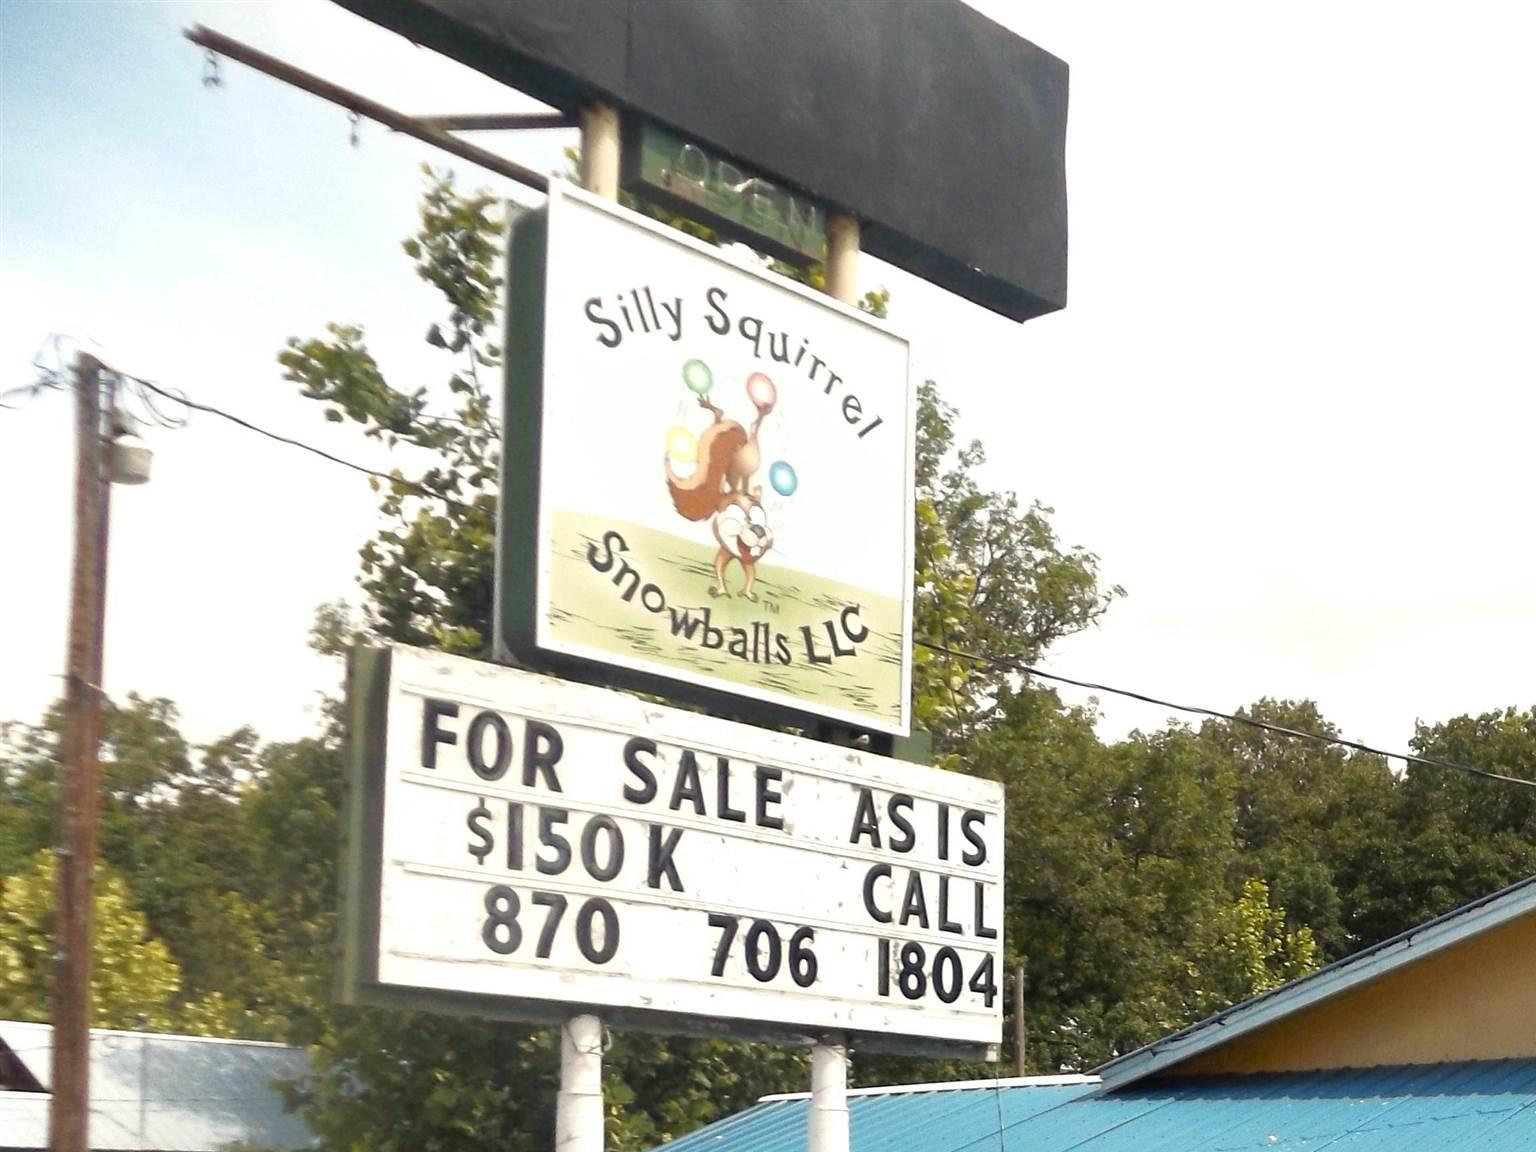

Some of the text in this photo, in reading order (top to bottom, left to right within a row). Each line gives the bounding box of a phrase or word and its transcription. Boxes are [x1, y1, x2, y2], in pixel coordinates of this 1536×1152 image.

[585, 285, 883, 438] Silly Squirrel
[587, 530, 869, 666] Snowballs LLC
[421, 698, 563, 793] FOR
[622, 736, 785, 830] SALE
[467, 798, 998, 939] $150K CALL
[481, 884, 998, 1009] 870 706 1804
